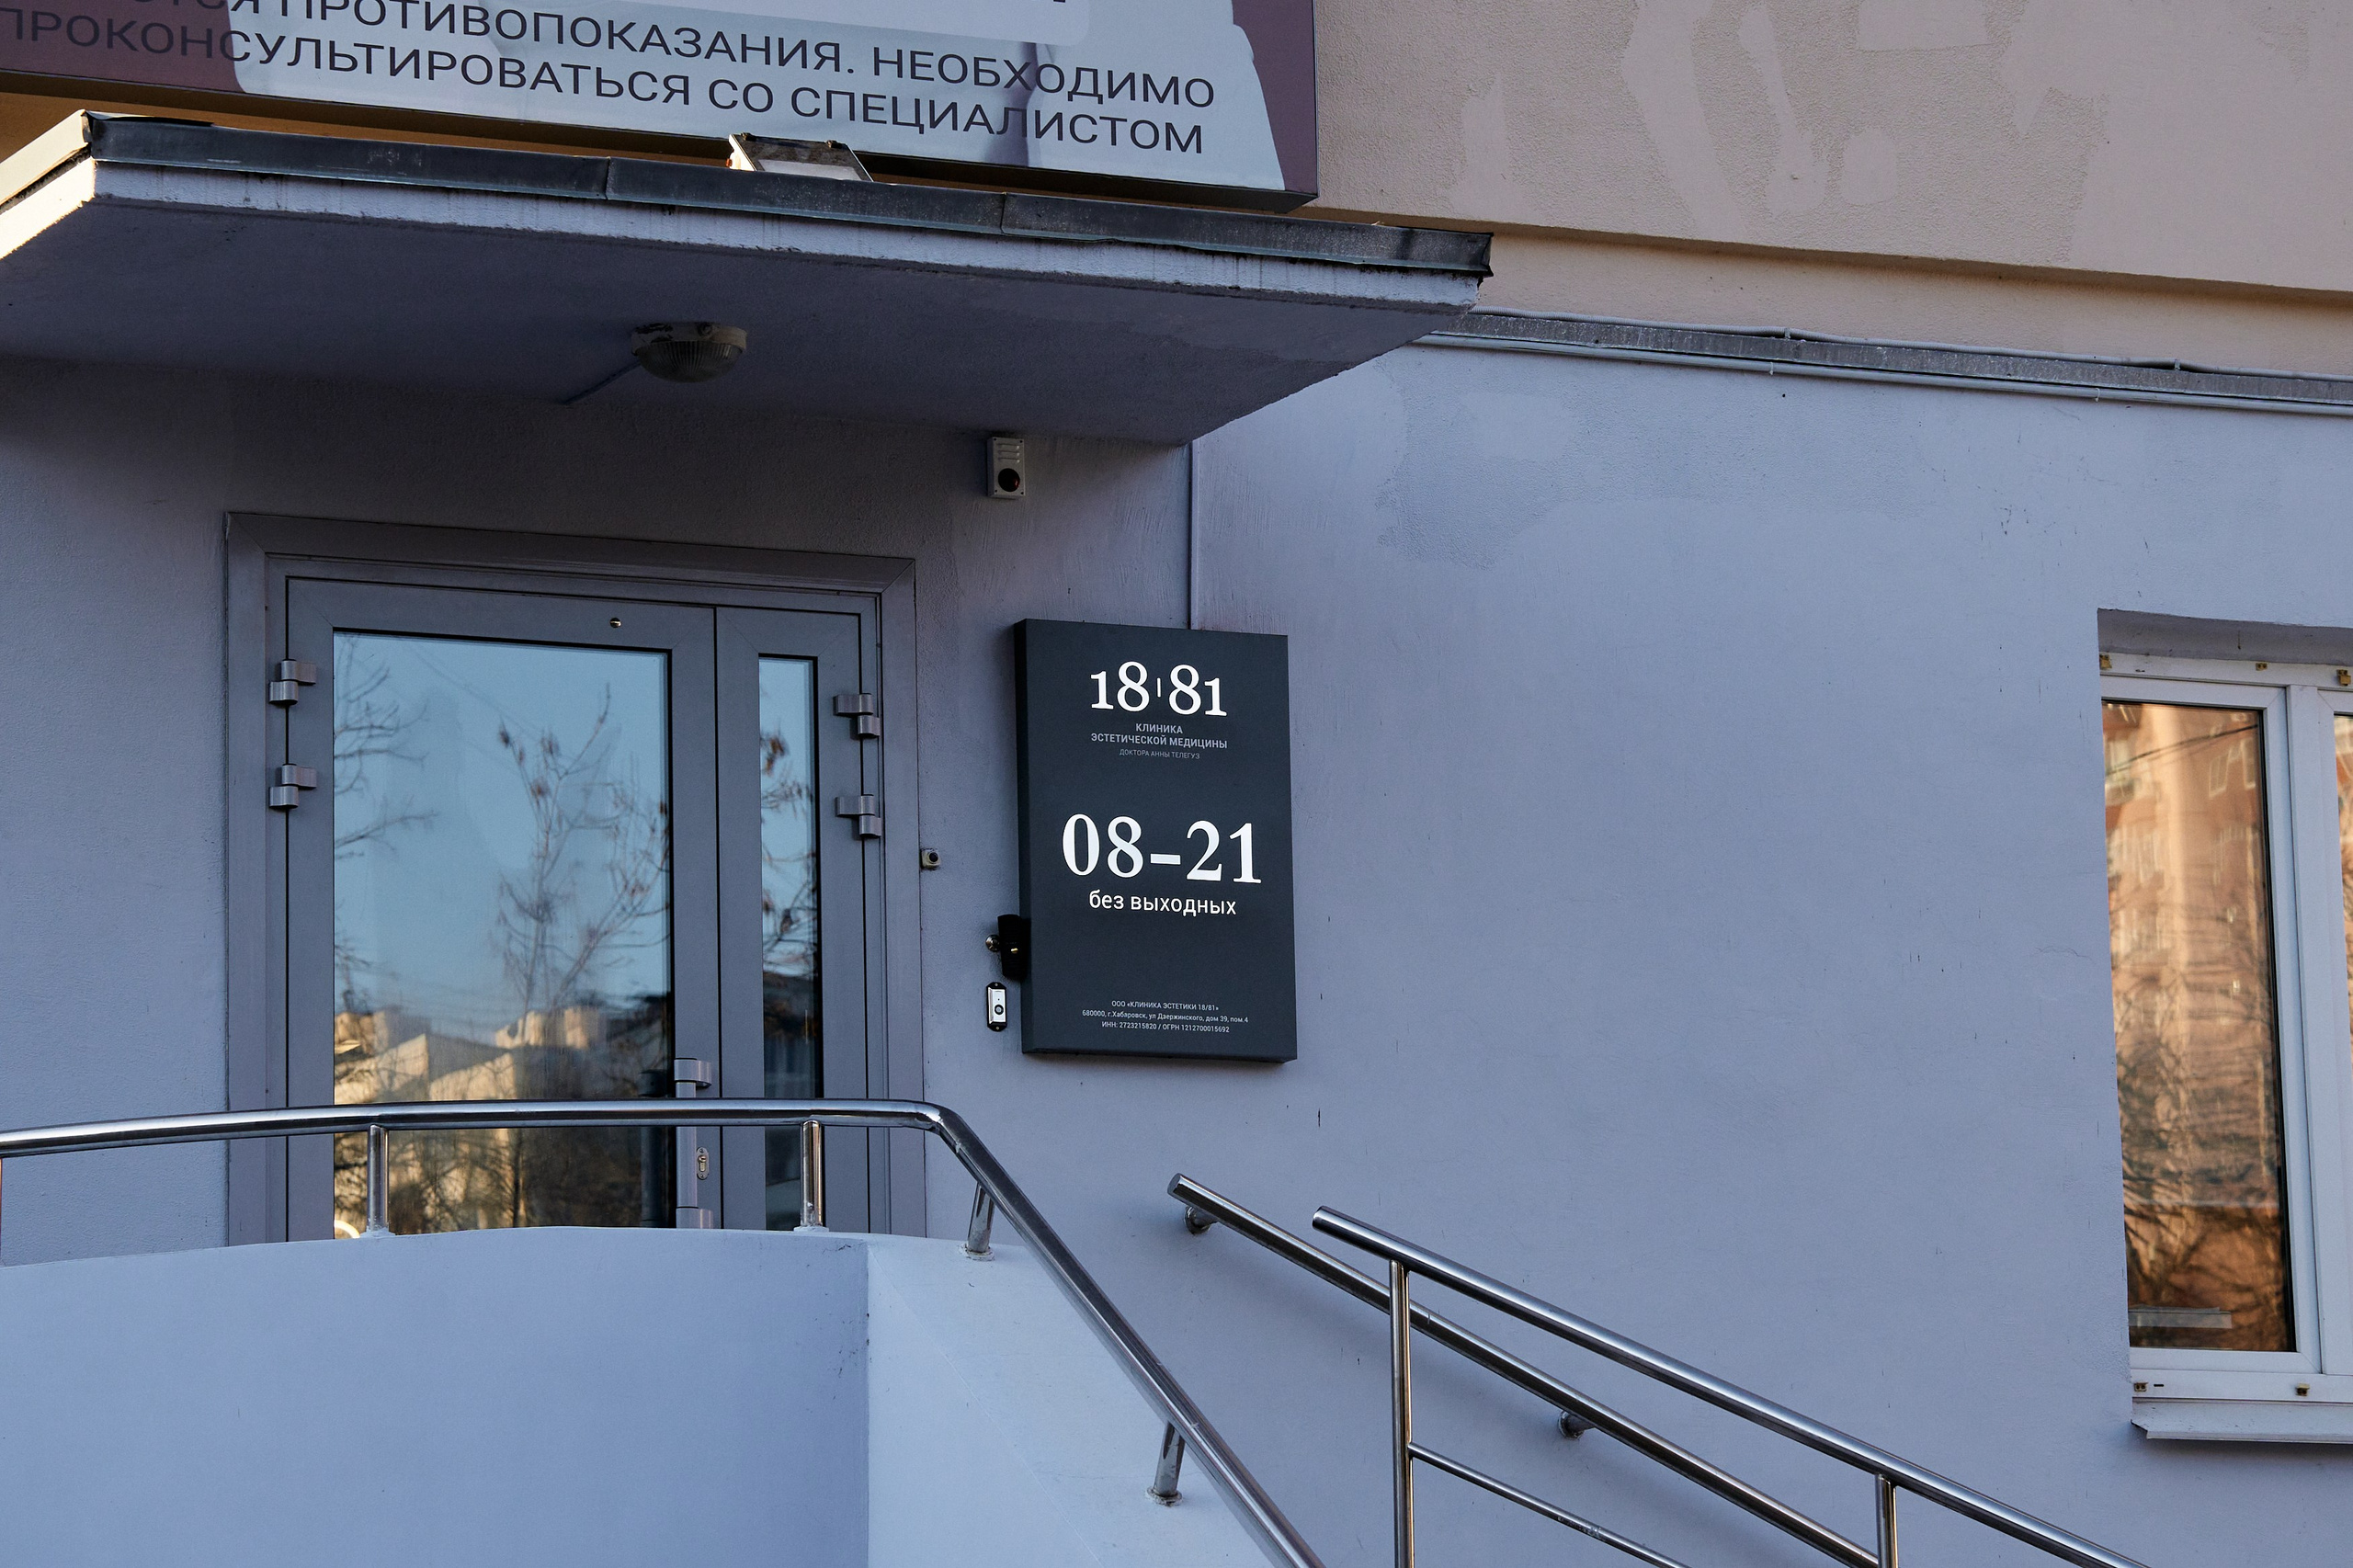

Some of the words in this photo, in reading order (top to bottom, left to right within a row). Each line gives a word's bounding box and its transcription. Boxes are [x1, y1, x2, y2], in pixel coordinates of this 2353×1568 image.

[873, 46, 1214, 108] НЕОБХОДИМО
[709, 79, 774, 113] СО
[790, 86, 1202, 154] СПЕЦИАЛИСТОМ
[1135, 722, 1184, 734] КЛИНИКА
[1090, 733, 1167, 745] ЭСТЕТИЧЕСКОЙ
[1169, 736, 1228, 750] МЕДИЦИНЫ
[1119, 748, 1150, 756] ДОКТОРА
[1150, 750, 1170, 758] АННЫ
[1089, 889, 1124, 910] без
[1131, 895, 1236, 917] выходных
[1163, 1002, 1197, 1010] ЭСТЕТИКИ
[1162, 1023, 1180, 1031] ОГРН
